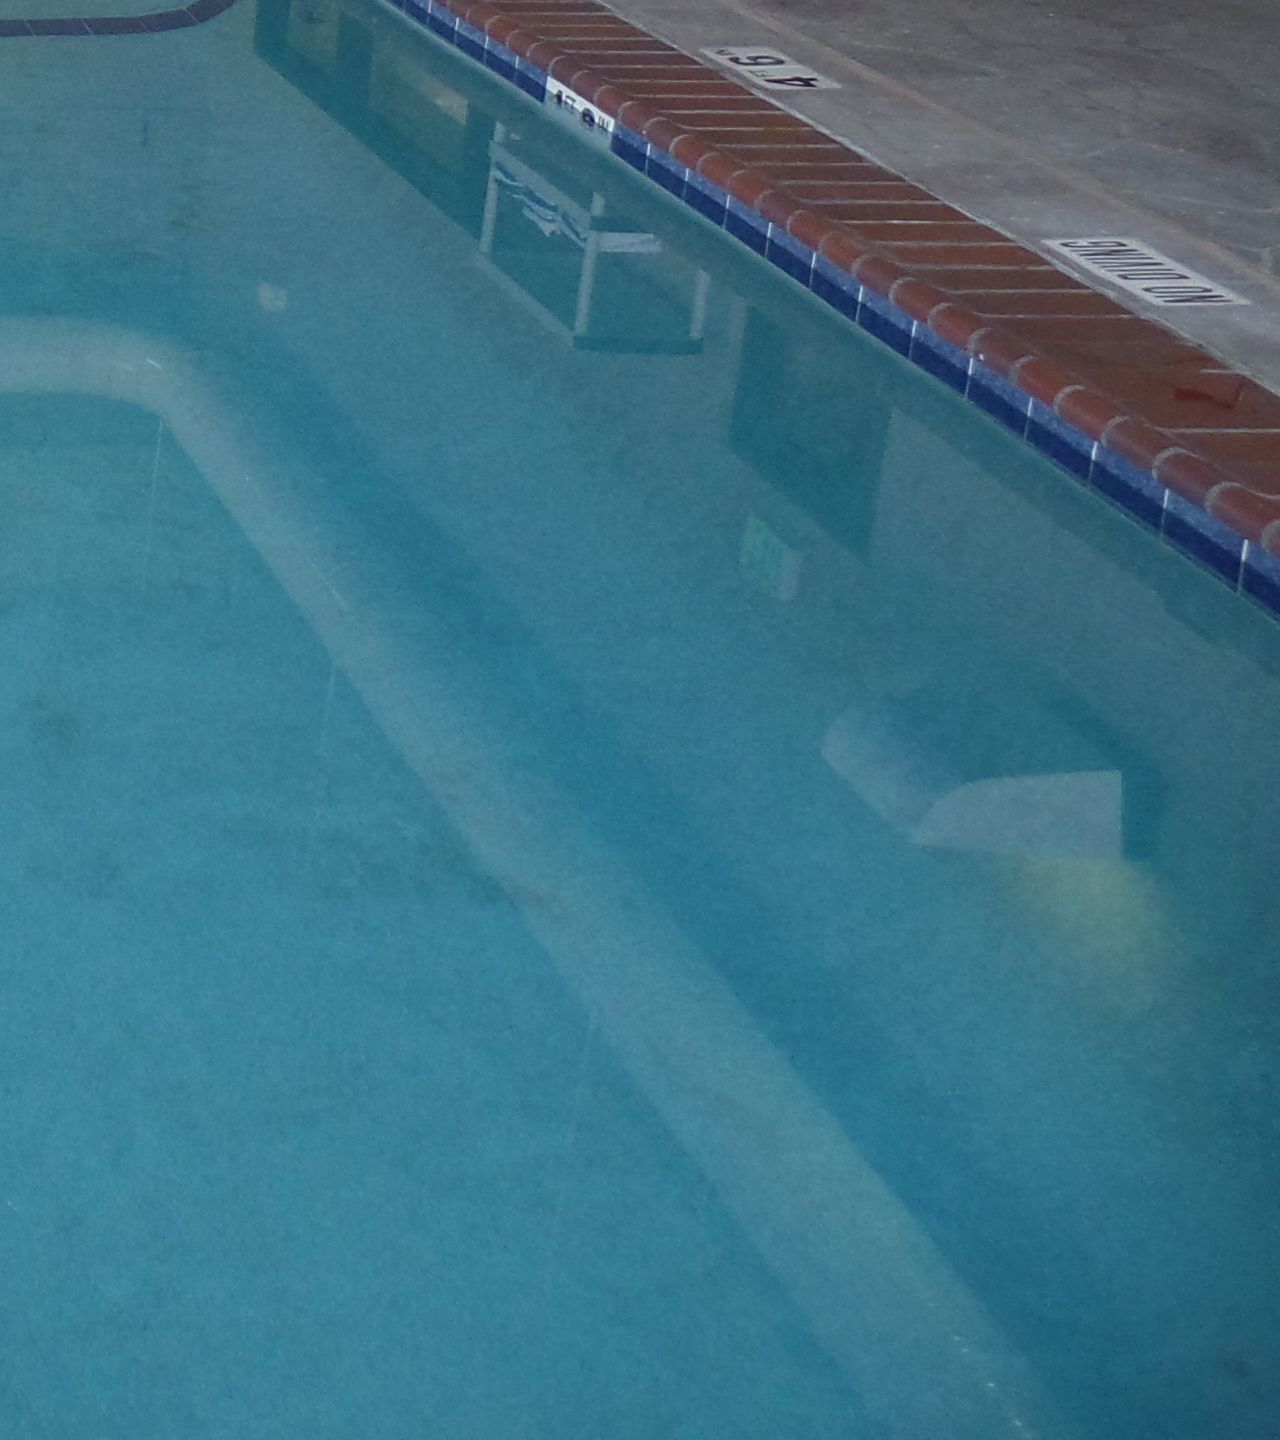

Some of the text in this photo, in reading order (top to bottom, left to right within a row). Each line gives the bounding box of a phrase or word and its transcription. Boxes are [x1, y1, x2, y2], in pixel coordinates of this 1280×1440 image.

[727, 54, 786, 66] 6
[764, 76, 819, 87] 4
[1059, 240, 1235, 304] NO DIVING
